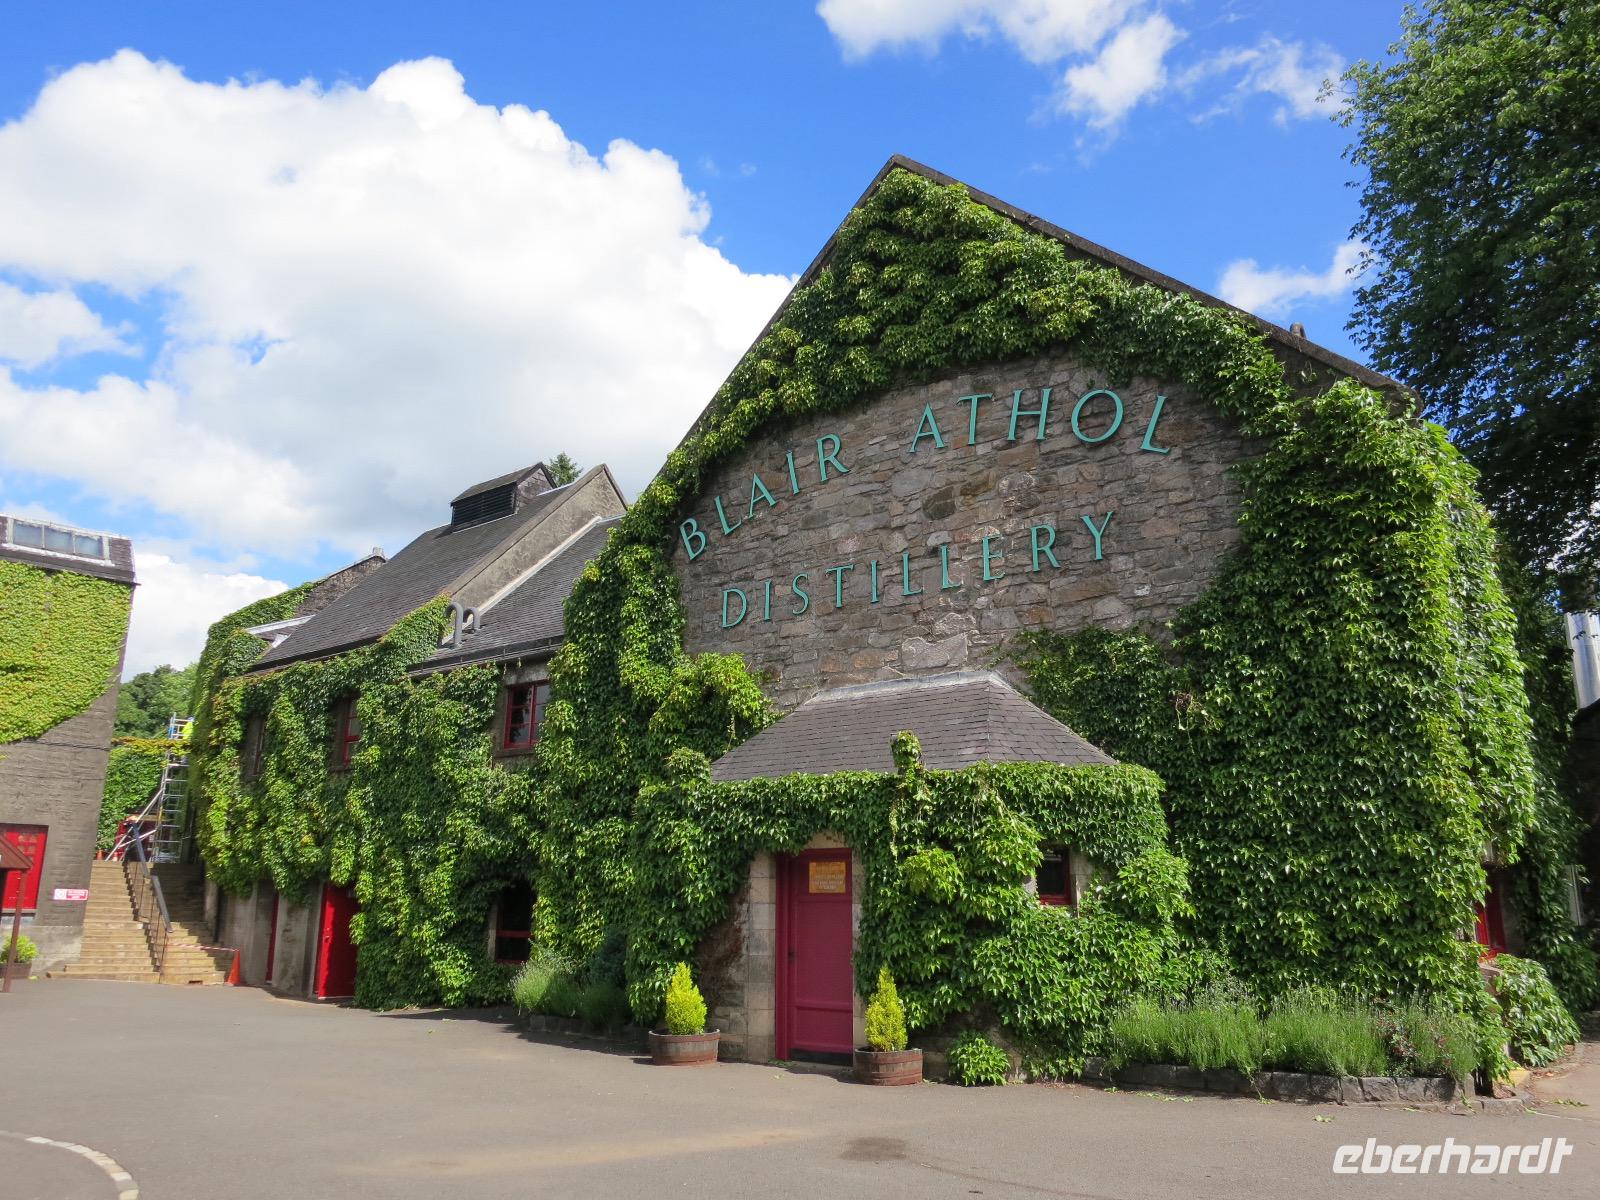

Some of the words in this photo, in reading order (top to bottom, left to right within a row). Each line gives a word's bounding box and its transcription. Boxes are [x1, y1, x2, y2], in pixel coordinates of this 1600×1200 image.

[679, 434, 850, 560] BLAIR
[908, 388, 1170, 453] ATHOL
[721, 511, 1113, 628] DISTILLERY
